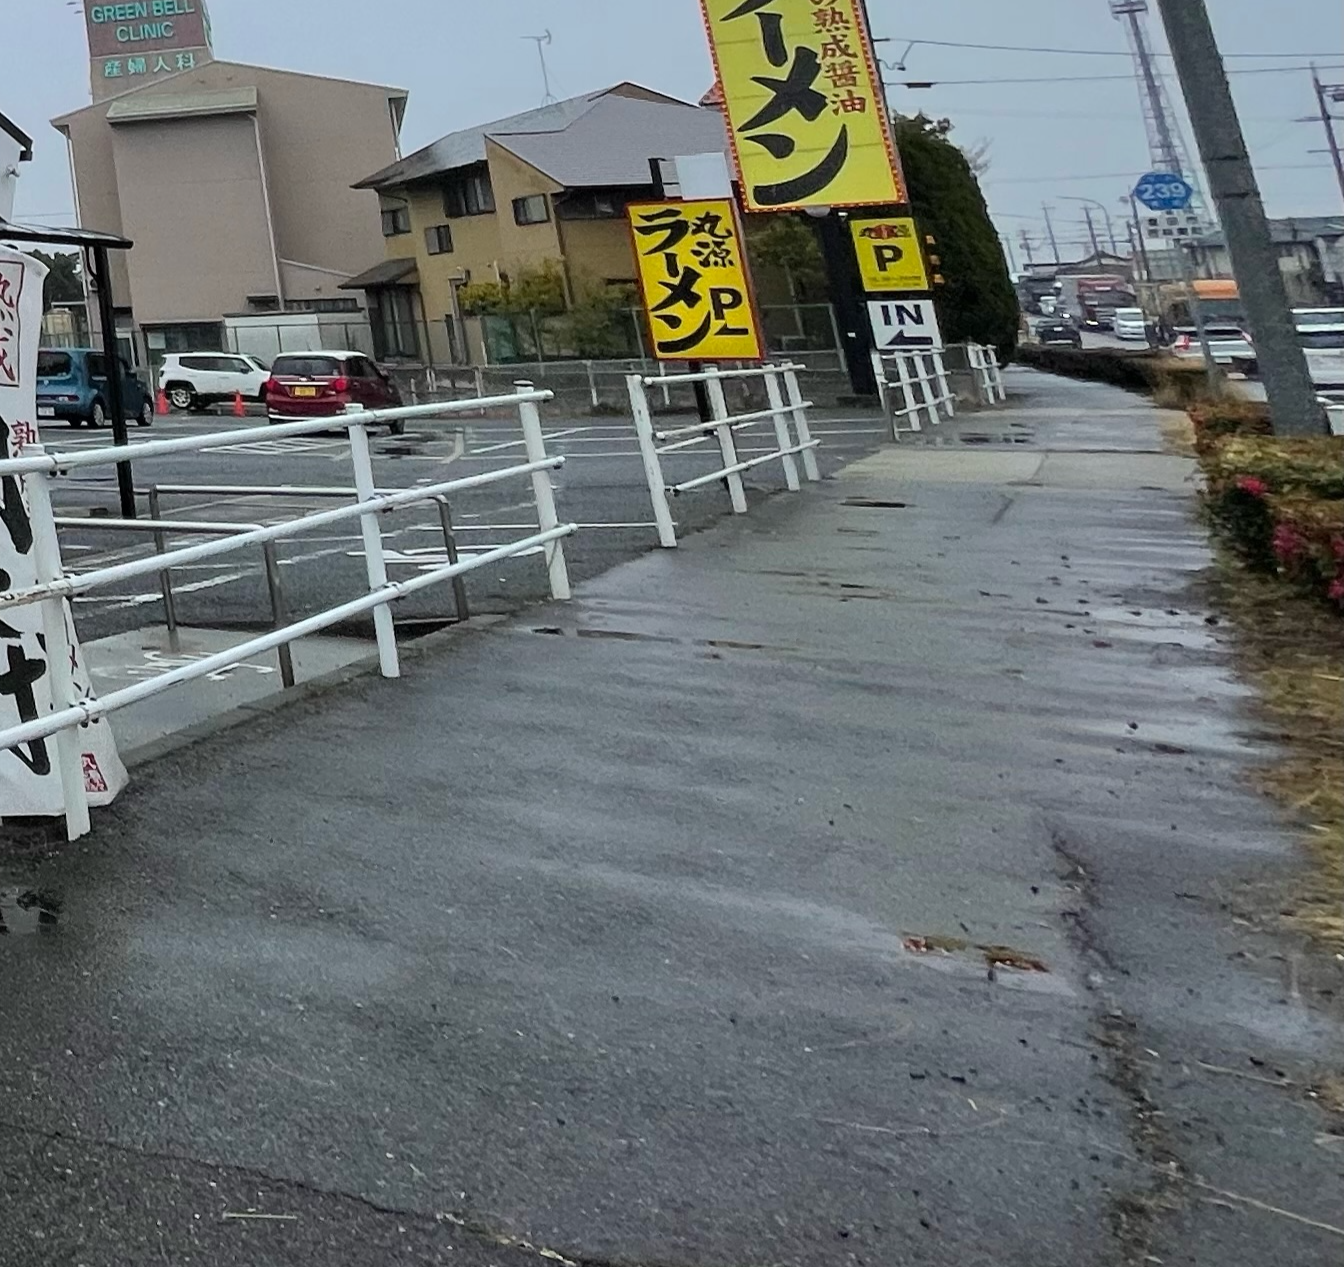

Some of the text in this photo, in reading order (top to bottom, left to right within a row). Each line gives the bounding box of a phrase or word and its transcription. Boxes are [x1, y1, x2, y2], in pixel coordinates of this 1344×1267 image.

[91, 1, 148, 23] GREEN
[116, 22, 175, 42] CLINIC
[103, 53, 196, 78] 産婦人科
[1137, 182, 1186, 201] 239
[690, 211, 735, 268] 丸源
[872, 244, 904, 272] P
[633, 209, 712, 353] ラーメン
[709, 288, 743, 321] P
[880, 304, 925, 326] IN
